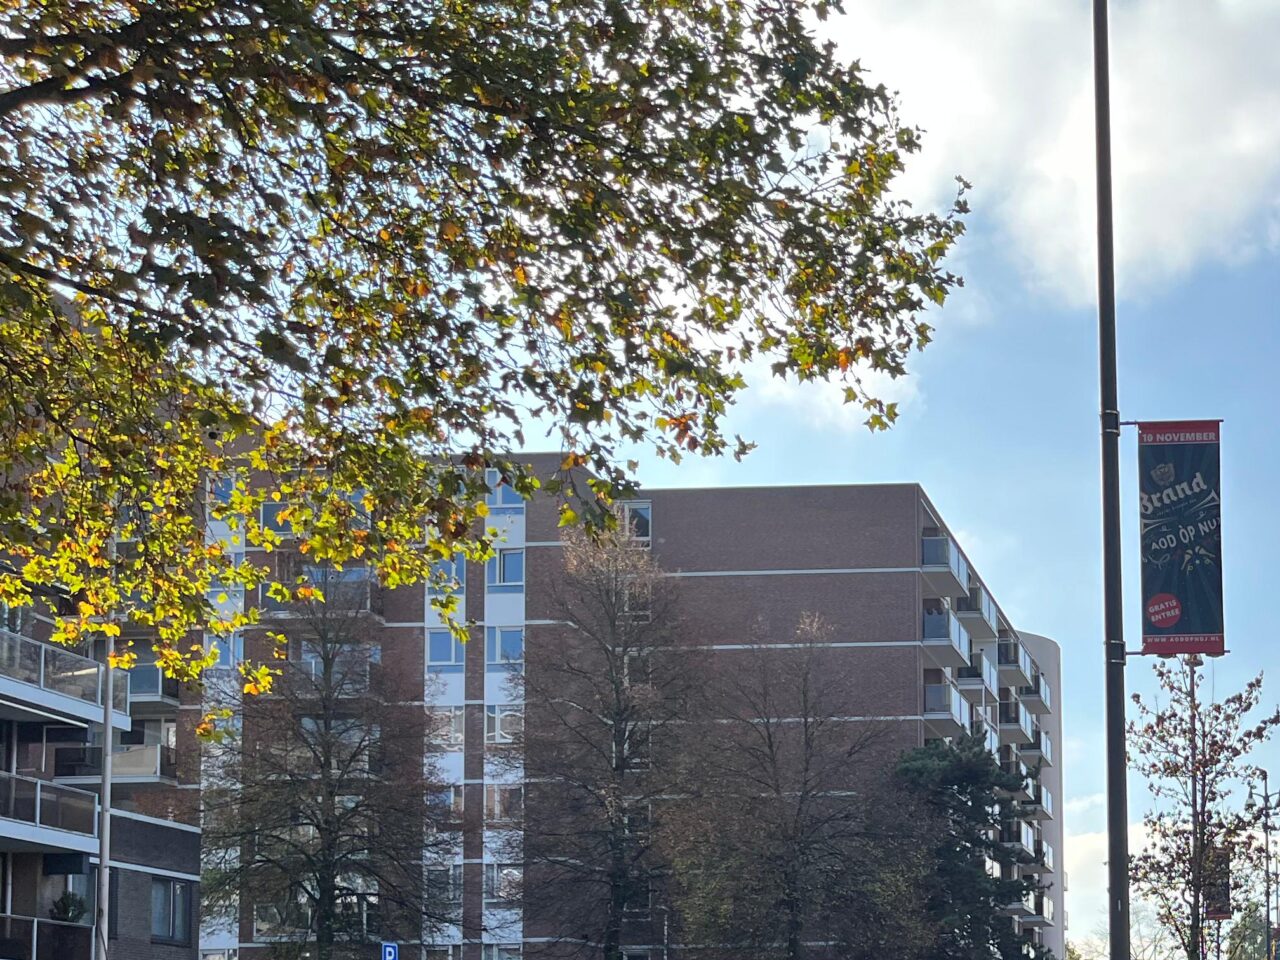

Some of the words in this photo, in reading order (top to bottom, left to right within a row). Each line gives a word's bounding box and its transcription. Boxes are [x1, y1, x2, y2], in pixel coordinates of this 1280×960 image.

[1142, 433, 1153, 442] 10
[1156, 432, 1216, 442] NOVEMBER
[1140, 472, 1207, 514] Brand
[1152, 534, 1177, 550] AOD
[1148, 600, 1177, 613] GRATIS
